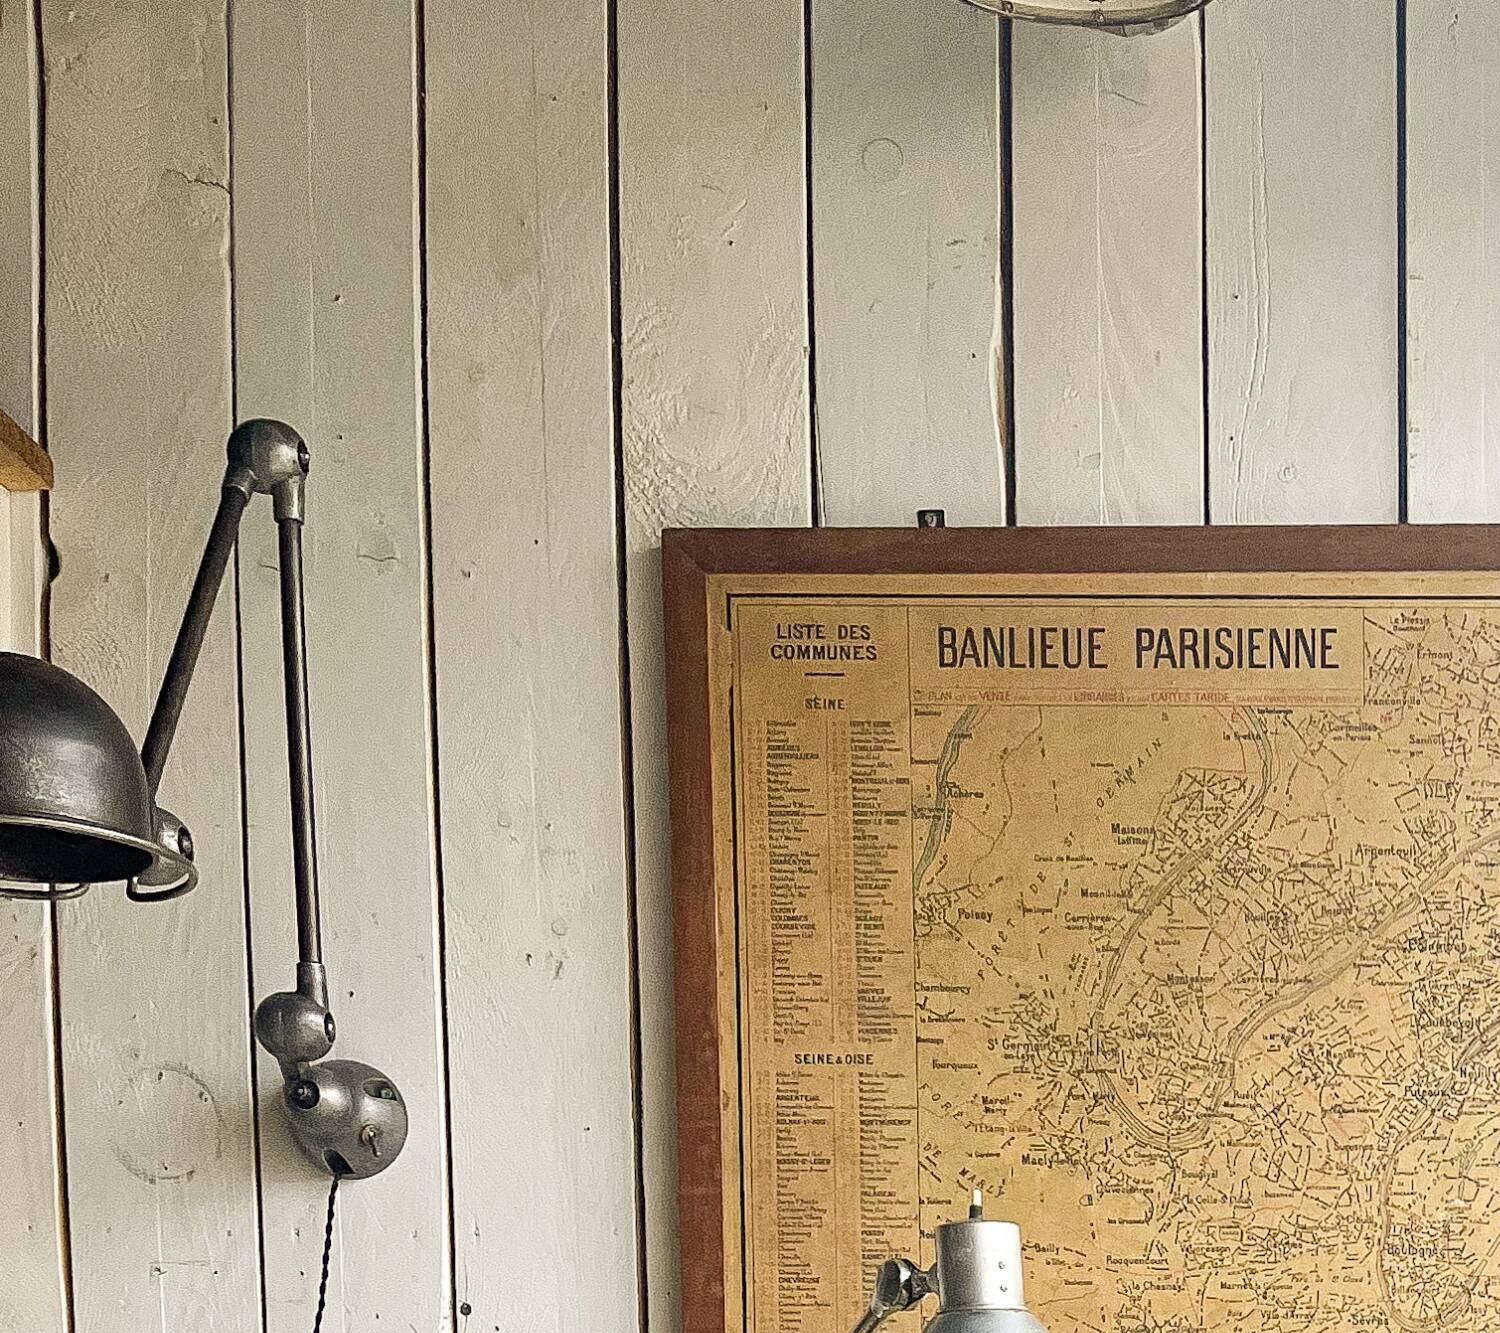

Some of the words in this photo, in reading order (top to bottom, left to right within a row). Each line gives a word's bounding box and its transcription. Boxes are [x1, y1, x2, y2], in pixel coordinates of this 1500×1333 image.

[776, 623, 825, 640] LISTE
[837, 624, 871, 640] DES
[770, 644, 877, 661] COMMUNES
[938, 626, 1108, 669] BANLIEUE
[1136, 627, 1340, 669] PARISIENNE
[804, 698, 845, 710] SEINE
